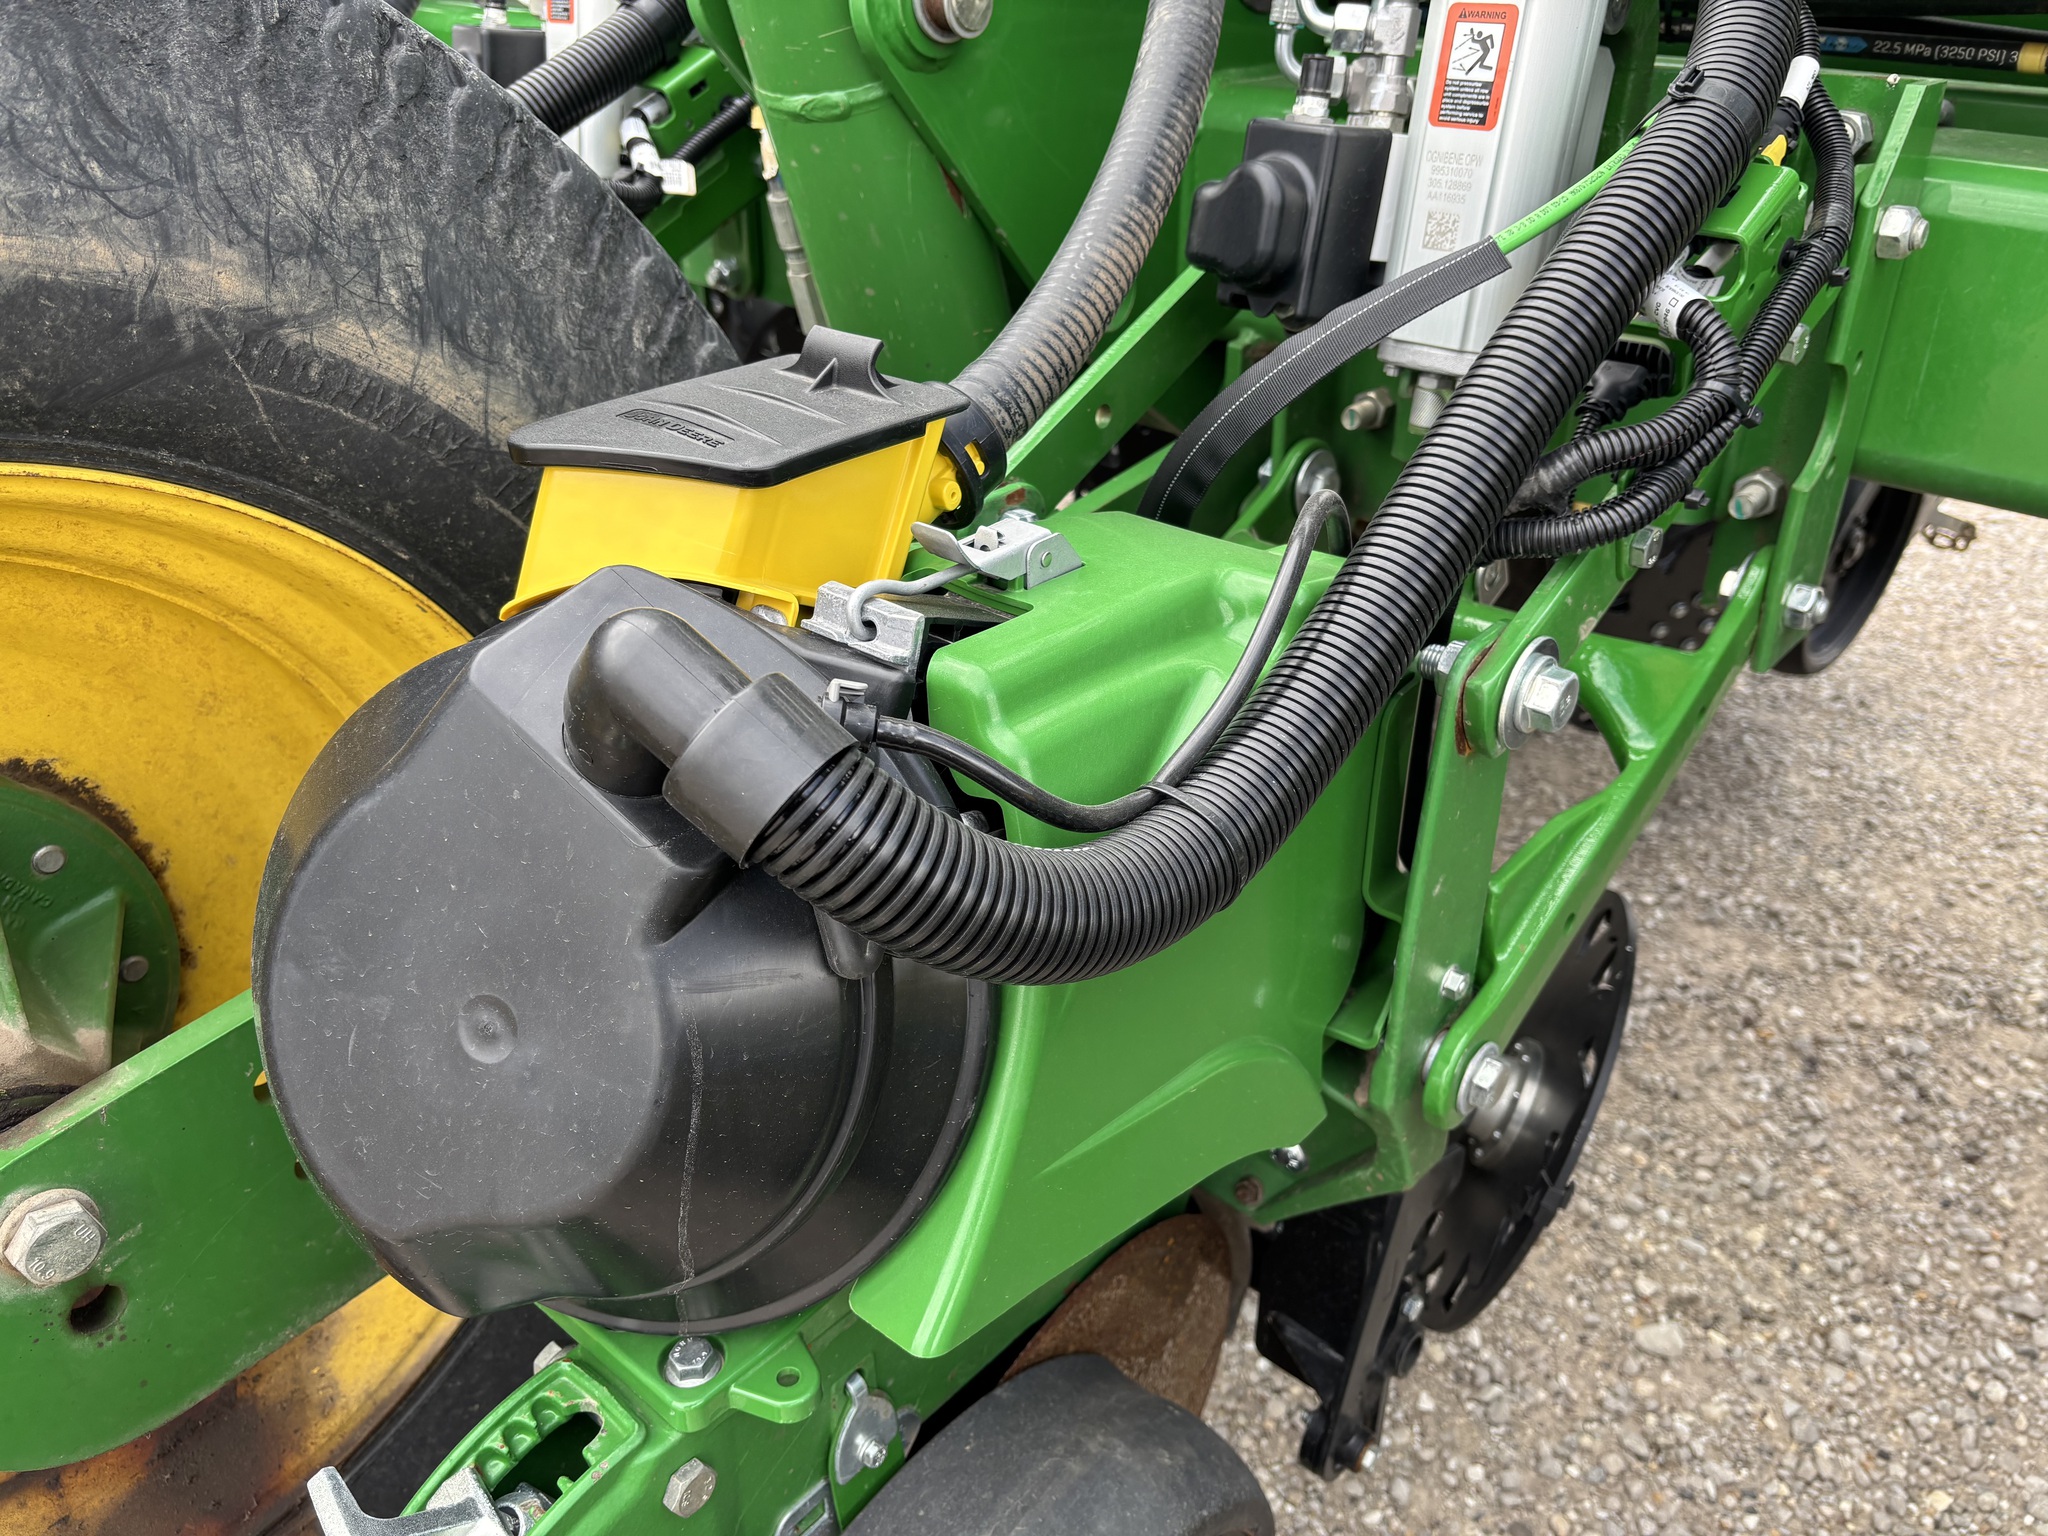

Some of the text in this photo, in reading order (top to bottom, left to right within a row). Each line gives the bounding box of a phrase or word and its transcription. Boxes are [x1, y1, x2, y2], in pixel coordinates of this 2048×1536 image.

[1467, 10, 1507, 20] WARNING
[1872, 40, 1902, 54] 22.5
[1903, 43, 1932, 57] MPa
[1934, 44, 1975, 60] (3250
[1977, 48, 2007, 66] PSI)
[623, 409, 725, 448] JOHN DEERE
[28, 1257, 57, 1281] 10.9
